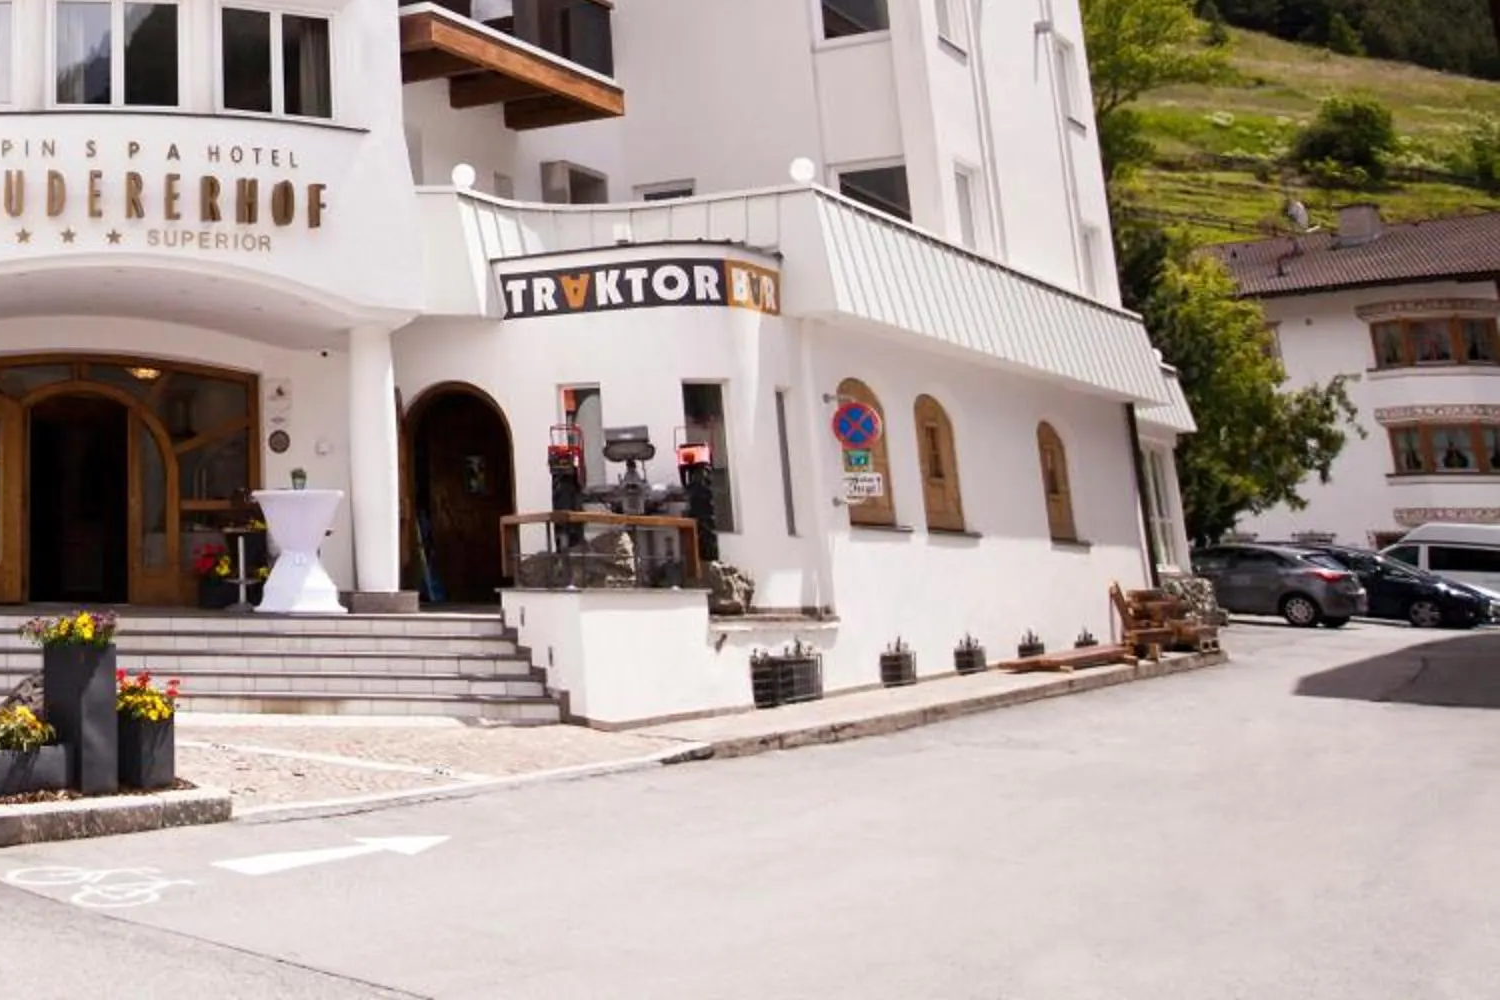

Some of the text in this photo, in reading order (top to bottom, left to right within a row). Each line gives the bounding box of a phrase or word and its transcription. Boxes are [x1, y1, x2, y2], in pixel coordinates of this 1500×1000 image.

[85, 140, 181, 161] SPA
[206, 144, 299, 168] HOTEL
[147, 229, 272, 252] SUPERIOR
